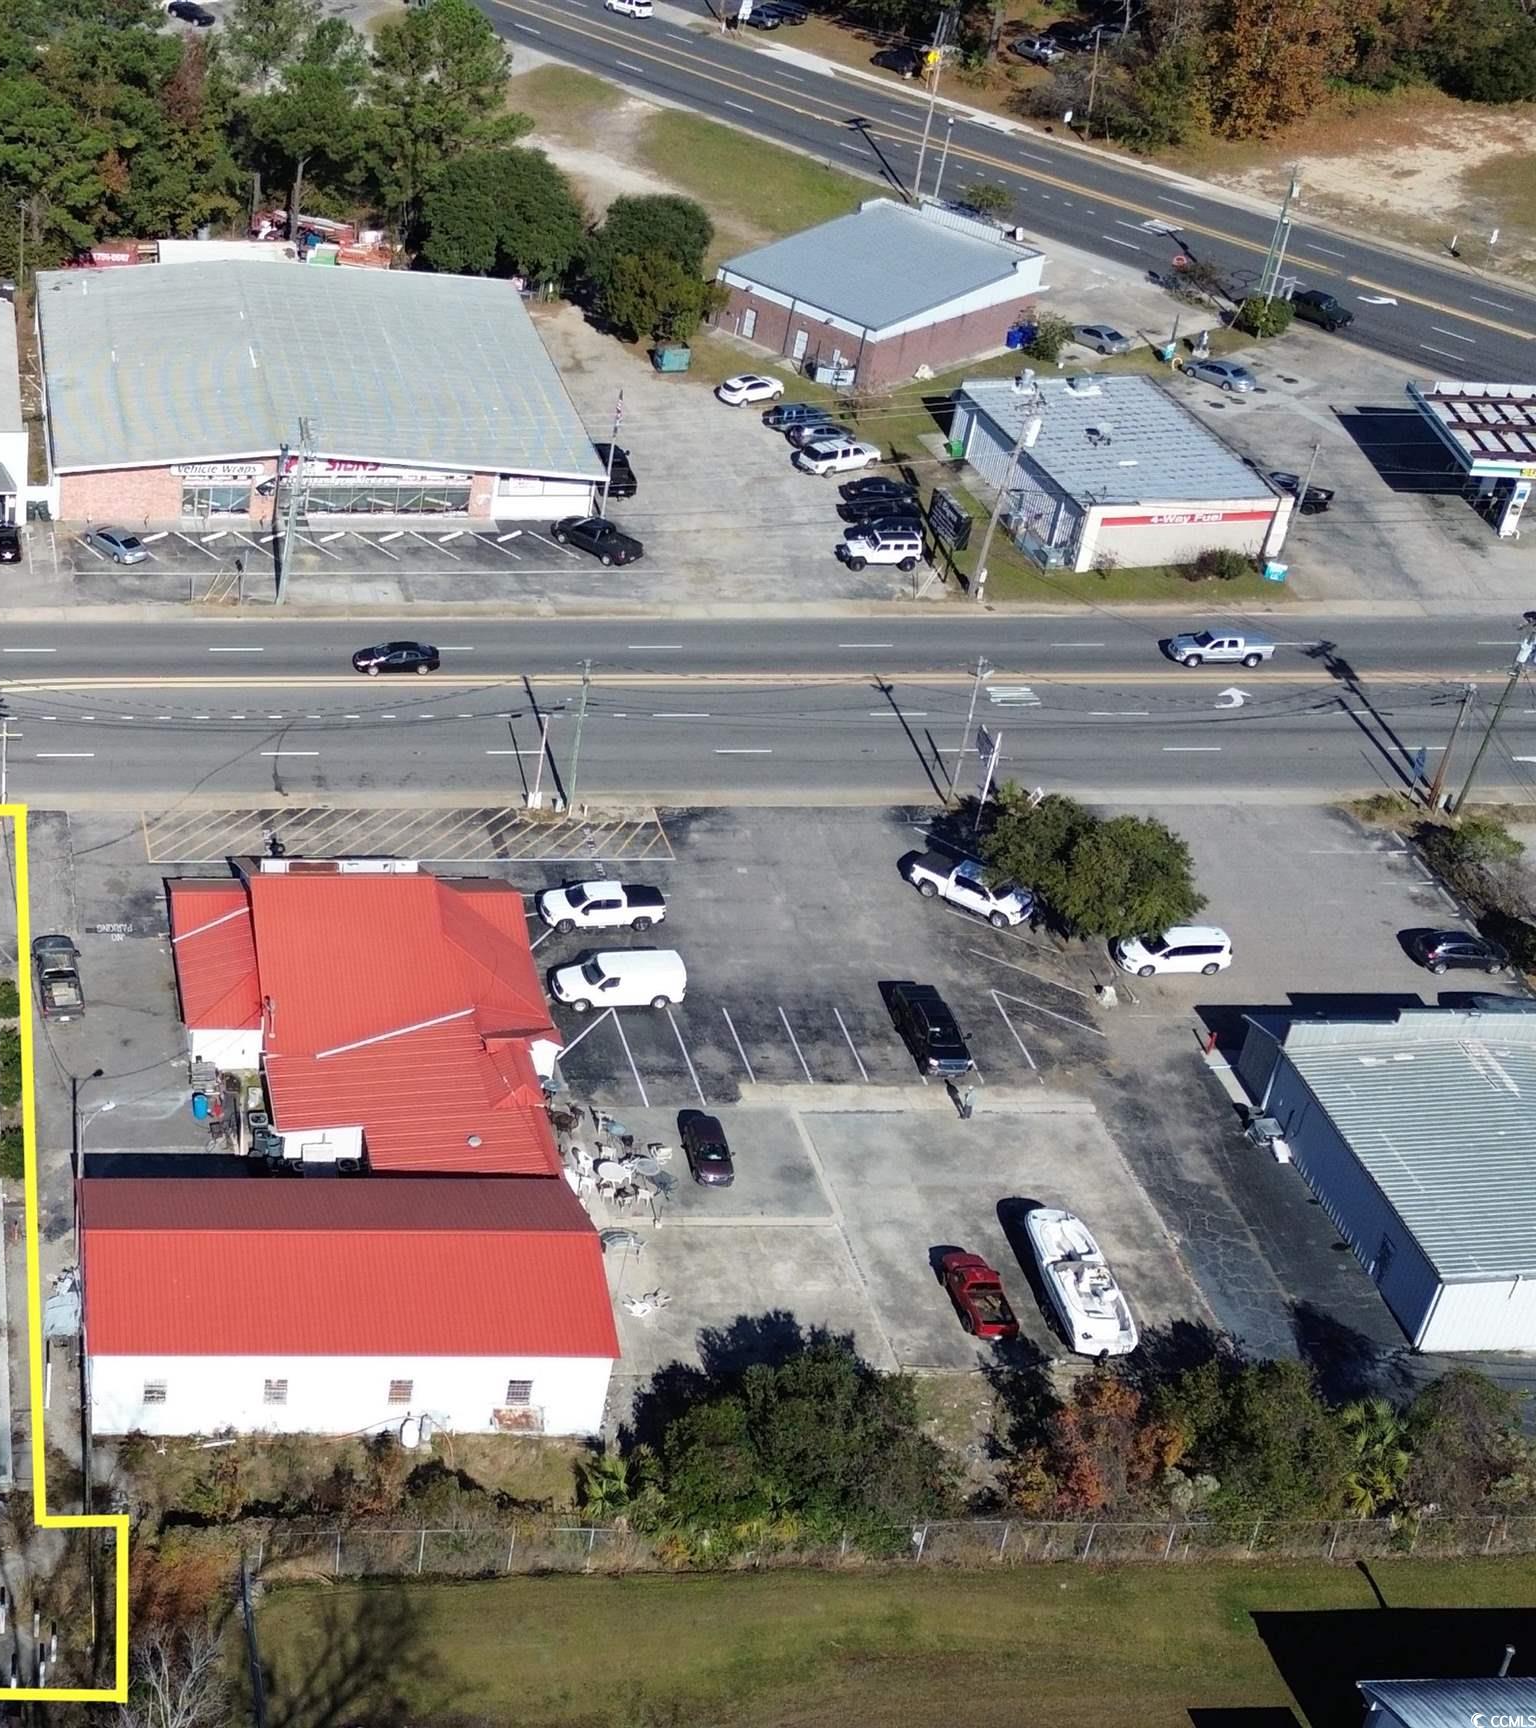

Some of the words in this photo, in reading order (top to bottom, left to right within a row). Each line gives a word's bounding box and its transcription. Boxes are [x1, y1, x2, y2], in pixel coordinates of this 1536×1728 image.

[177, 464, 218, 474] Vehicle
[222, 464, 257, 475] Wraps
[1151, 514, 1191, 524] 4-Way
[1193, 513, 1223, 523] Fuel
